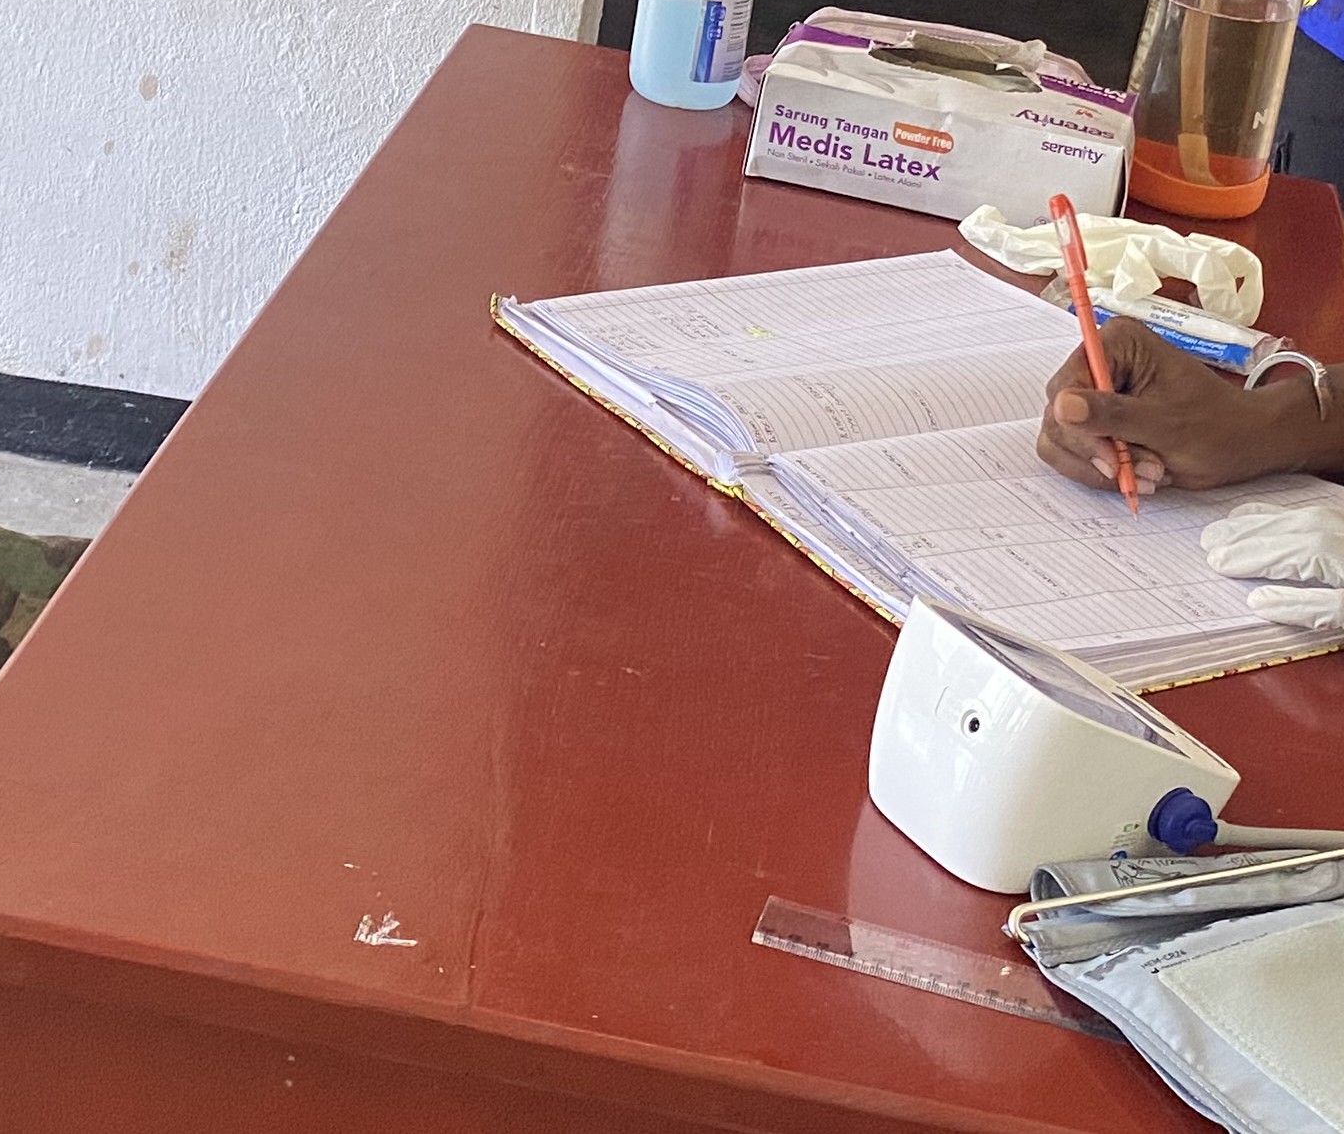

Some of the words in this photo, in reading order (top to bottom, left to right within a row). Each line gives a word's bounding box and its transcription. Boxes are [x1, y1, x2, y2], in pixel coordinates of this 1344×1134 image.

[775, 104, 829, 129] Sarung
[834, 118, 889, 141] Tangan
[1015, 109, 1115, 140] serenity
[768, 122, 853, 161] Medis
[862, 143, 942, 181] Latex
[895, 127, 931, 146] Powder
[932, 136, 952, 150] Free
[1041, 141, 1104, 164] serenity
